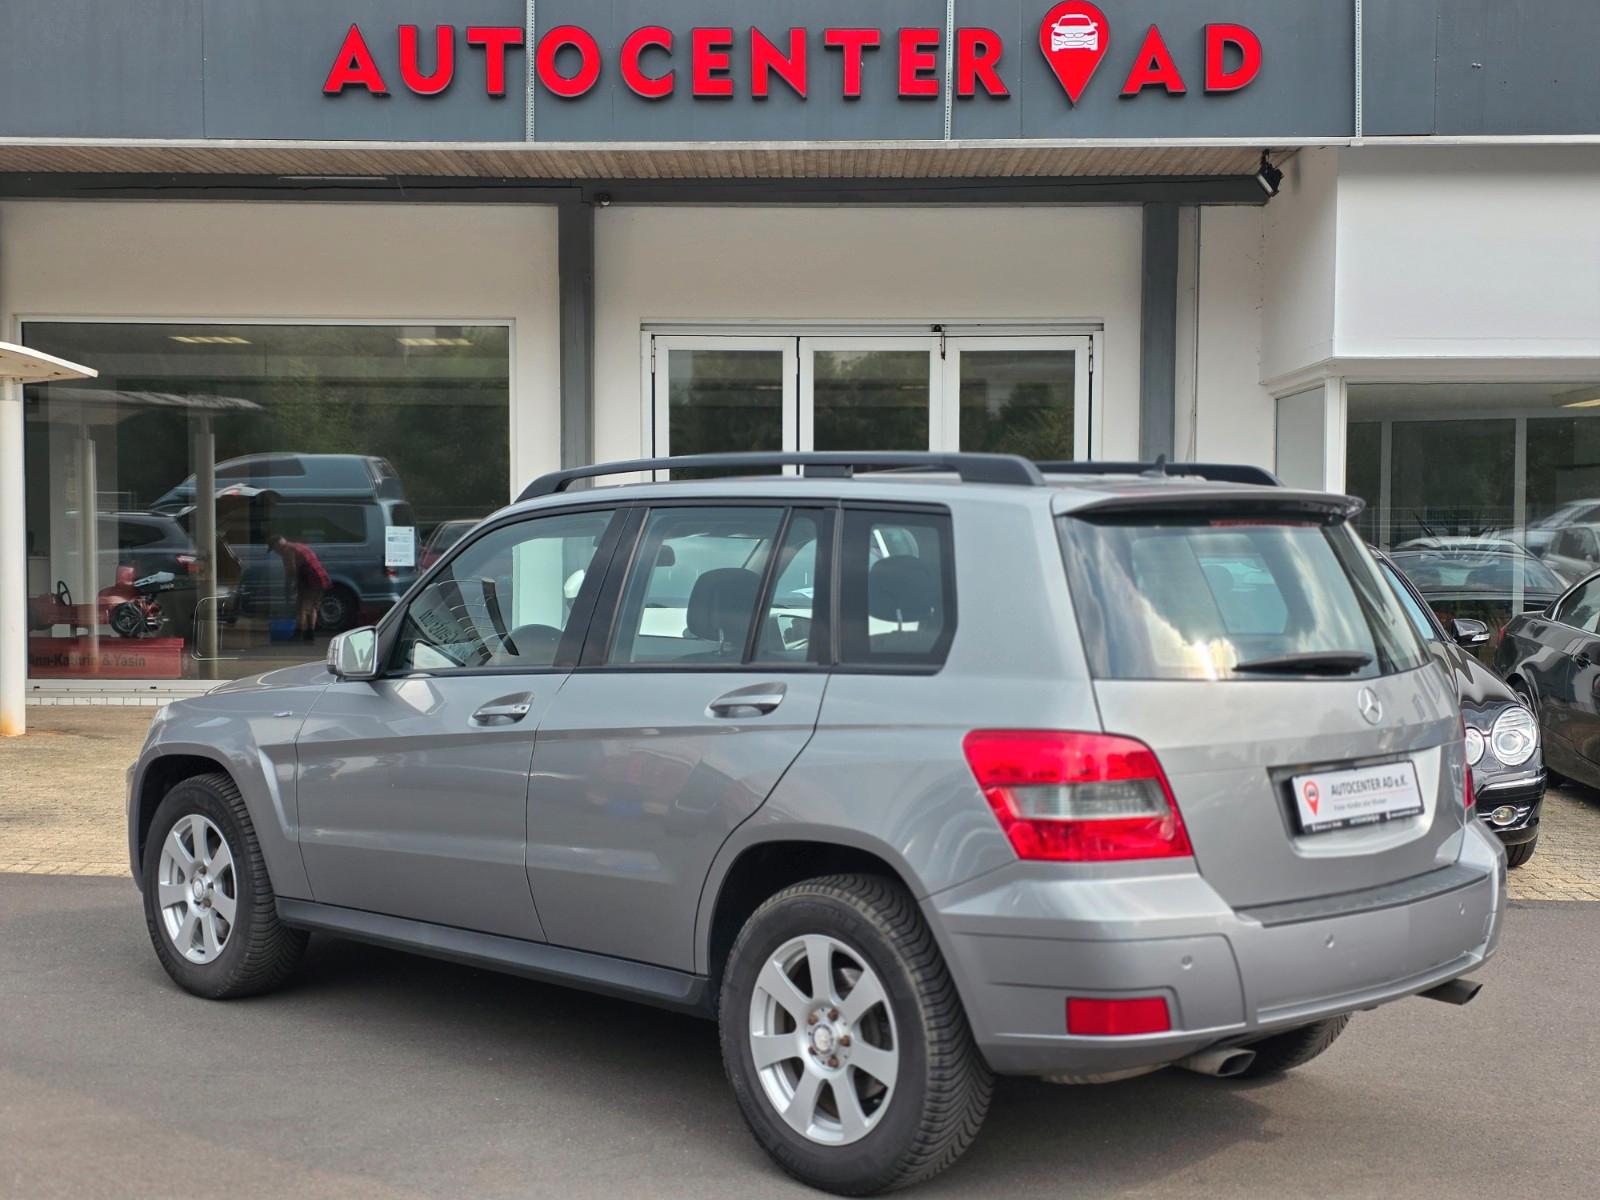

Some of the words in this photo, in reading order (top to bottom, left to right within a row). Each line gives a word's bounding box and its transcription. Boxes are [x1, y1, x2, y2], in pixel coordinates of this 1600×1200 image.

[323, 24, 1009, 98] AUTOCENTER
[1121, 24, 1264, 95] AD
[102, 654, 113, 667] &
[114, 653, 146, 668] Yasin
[1331, 778, 1380, 796] AUTOCENTER
[1383, 776, 1393, 788] AD
